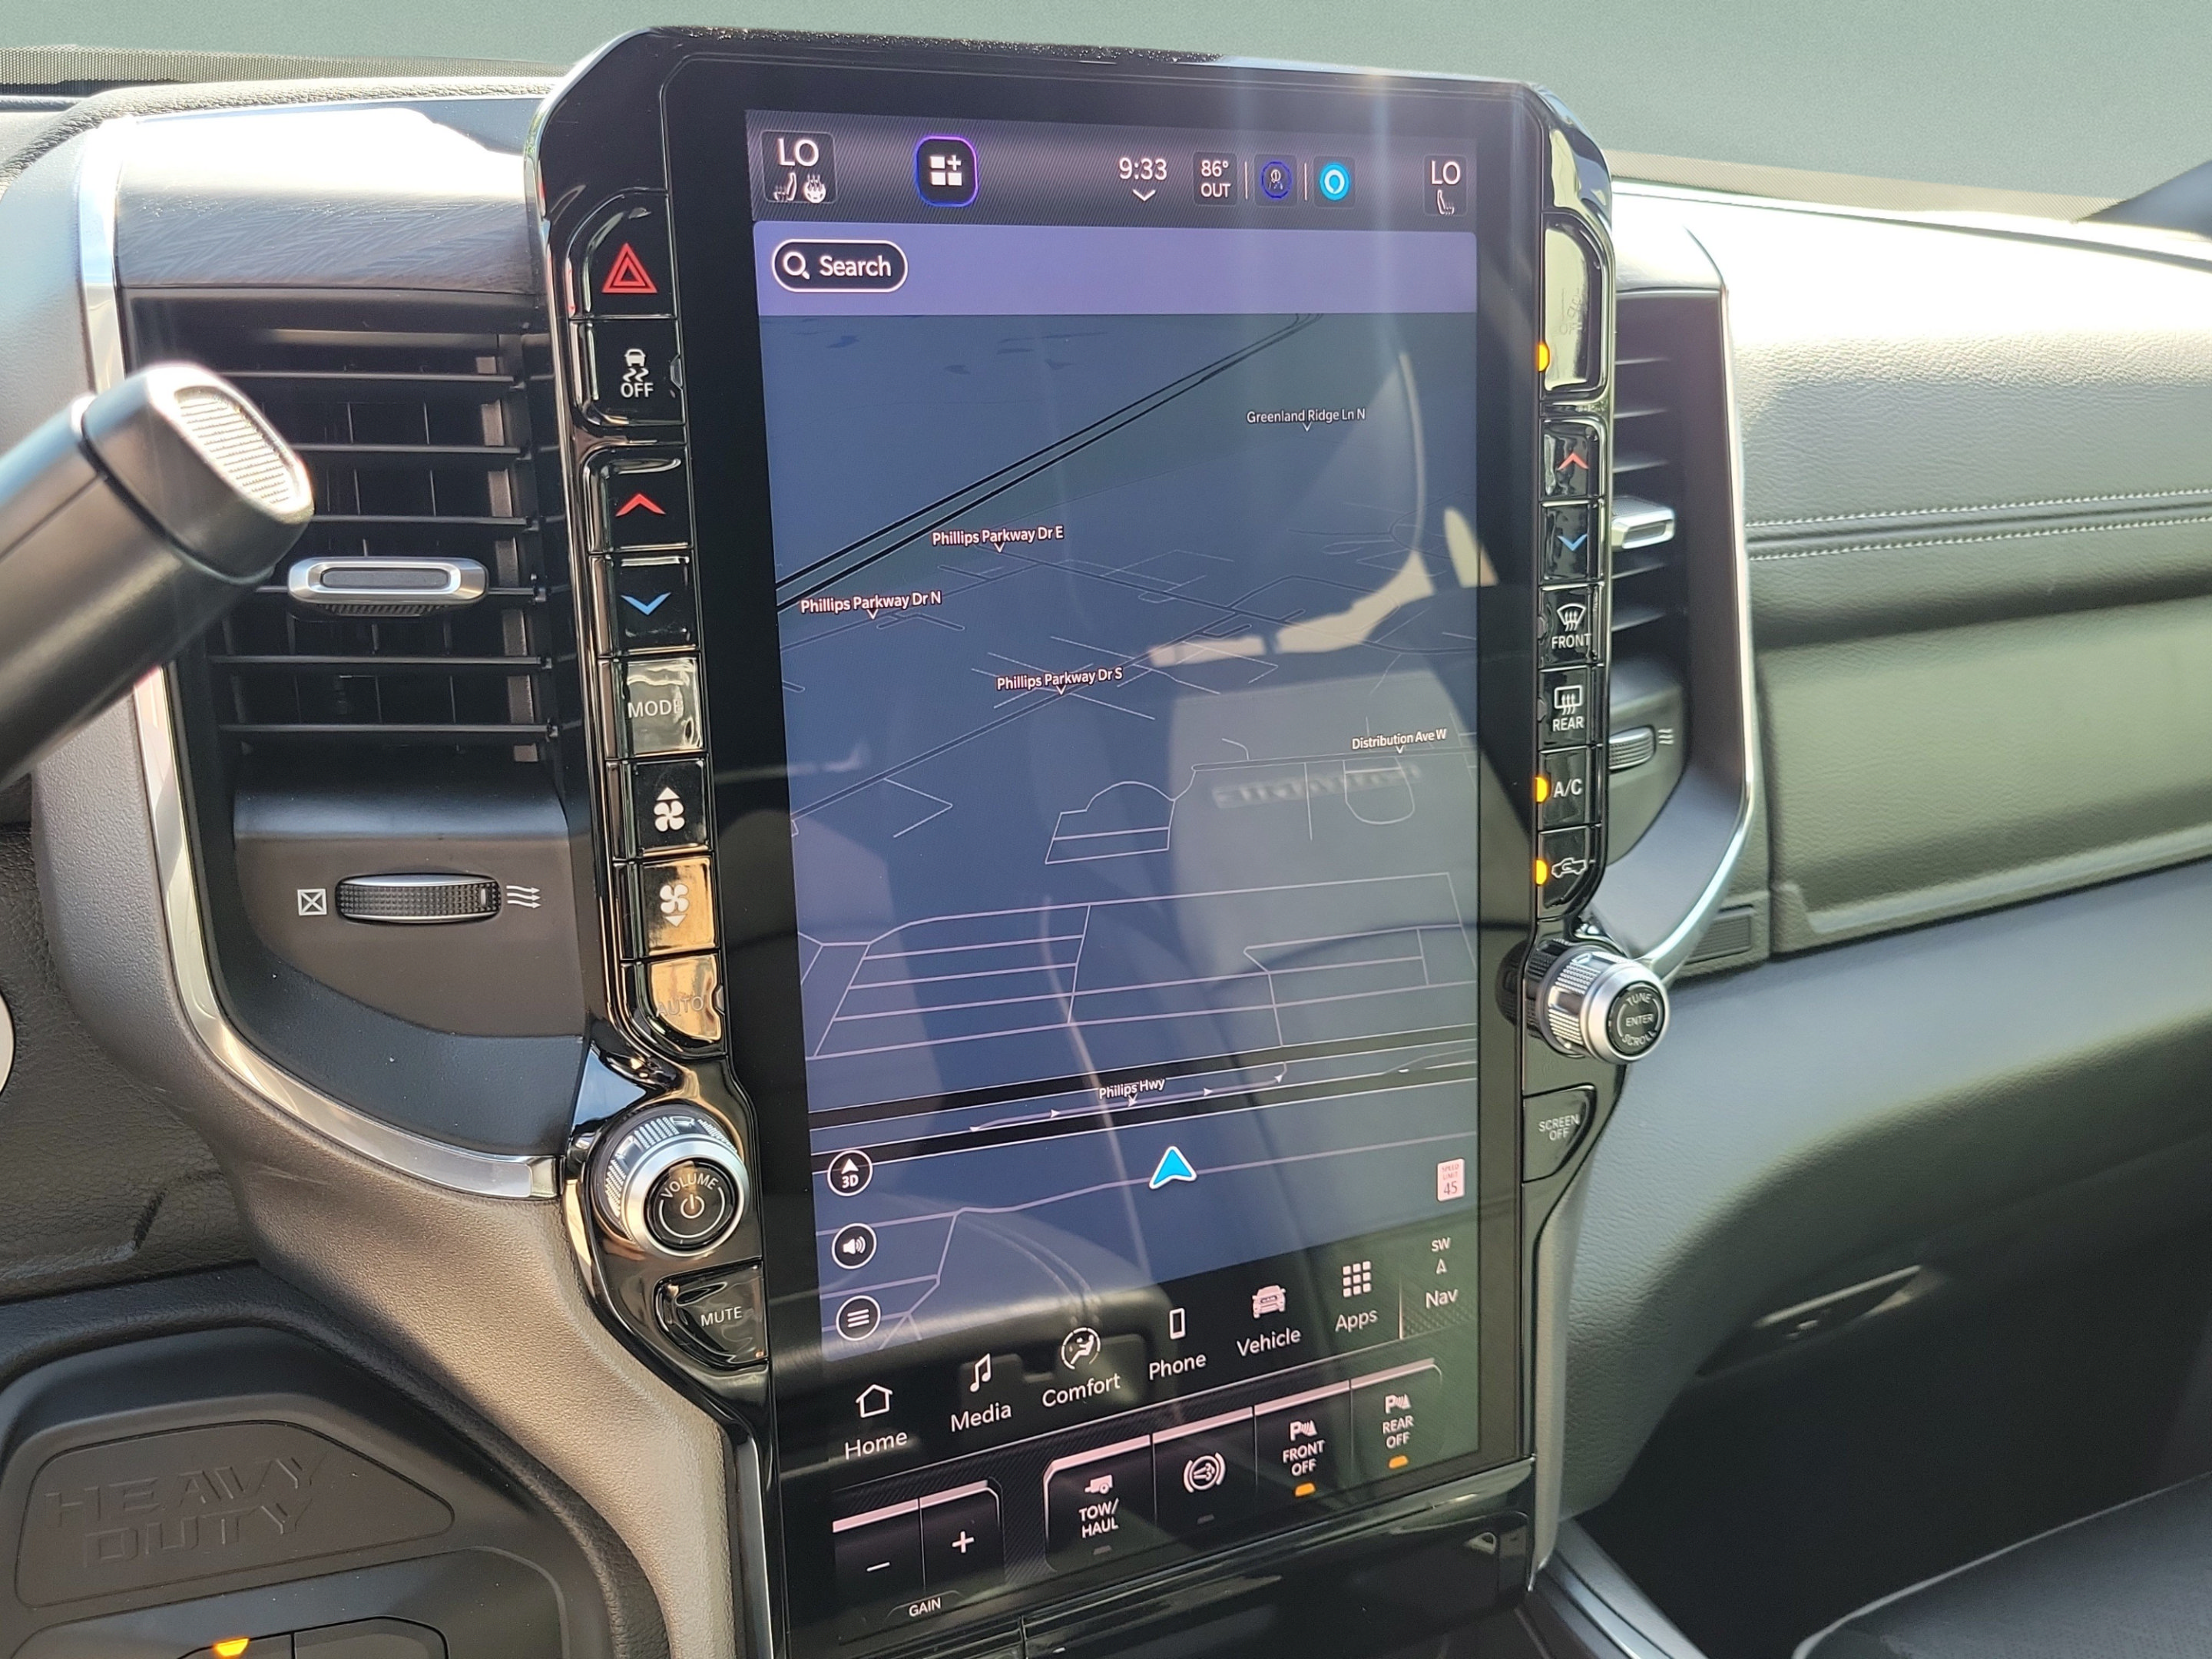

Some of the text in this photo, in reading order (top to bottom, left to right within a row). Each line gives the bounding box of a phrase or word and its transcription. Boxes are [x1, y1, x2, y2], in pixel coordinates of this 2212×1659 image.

[777, 137, 820, 167] LO
[1118, 157, 1167, 180] 9:33
[1200, 160, 1229, 177] 86°
[1431, 160, 1461, 185] LO
[1200, 183, 1230, 198] OUT
[820, 255, 892, 277] Search
[621, 382, 654, 398] OFF
[1247, 408, 1366, 423] Greenland Ridge Ln N
[932, 525, 1064, 546] Phillips Parkway Dr E
[800, 591, 942, 614] Phillips Parkway Dr N
[1551, 634, 1591, 649] FRONT
[997, 667, 1123, 690] Phillips Parkway Dr S
[1552, 717, 1584, 731] REAR
[1352, 729, 1447, 750] Distribution Ave W
[1553, 778, 1582, 797] A/C
[1626, 993, 1652, 1006] TUNE
[1626, 1014, 1654, 1027] ENTER
[1621, 1031, 1657, 1046] SCROLL
[1099, 1078, 1165, 1100] Philips Hwy
[1538, 1114, 1580, 1132] SCREEN
[1549, 1127, 1569, 1141] OFF
[661, 1173, 719, 1199] VOLUME
[842, 1174, 859, 1188] 3D
[1444, 1181, 1458, 1195] 45
[1431, 1237, 1452, 1252] SW
[1426, 1289, 1459, 1309] Nav
[700, 1306, 743, 1326] MUTE
[1335, 1310, 1379, 1333] Apps
[1237, 1326, 1302, 1356] Vehicle
[1149, 1353, 1207, 1380] Phone
[1041, 1373, 1121, 1408] Comfort
[950, 1402, 1012, 1432] Media
[1382, 1415, 1414, 1434] REAR
[844, 1432, 908, 1459] Home
[1386, 1432, 1411, 1449] OFF
[1283, 1439, 1326, 1463] FRONT
[1291, 1459, 1316, 1476] OFF
[44, 1454, 326, 1528] HEAVY
[1078, 1498, 1119, 1522] TOW/
[83, 1499, 312, 1568] DUTY
[1081, 1518, 1119, 1538] HAUL
[909, 1598, 942, 1618] GAIN
